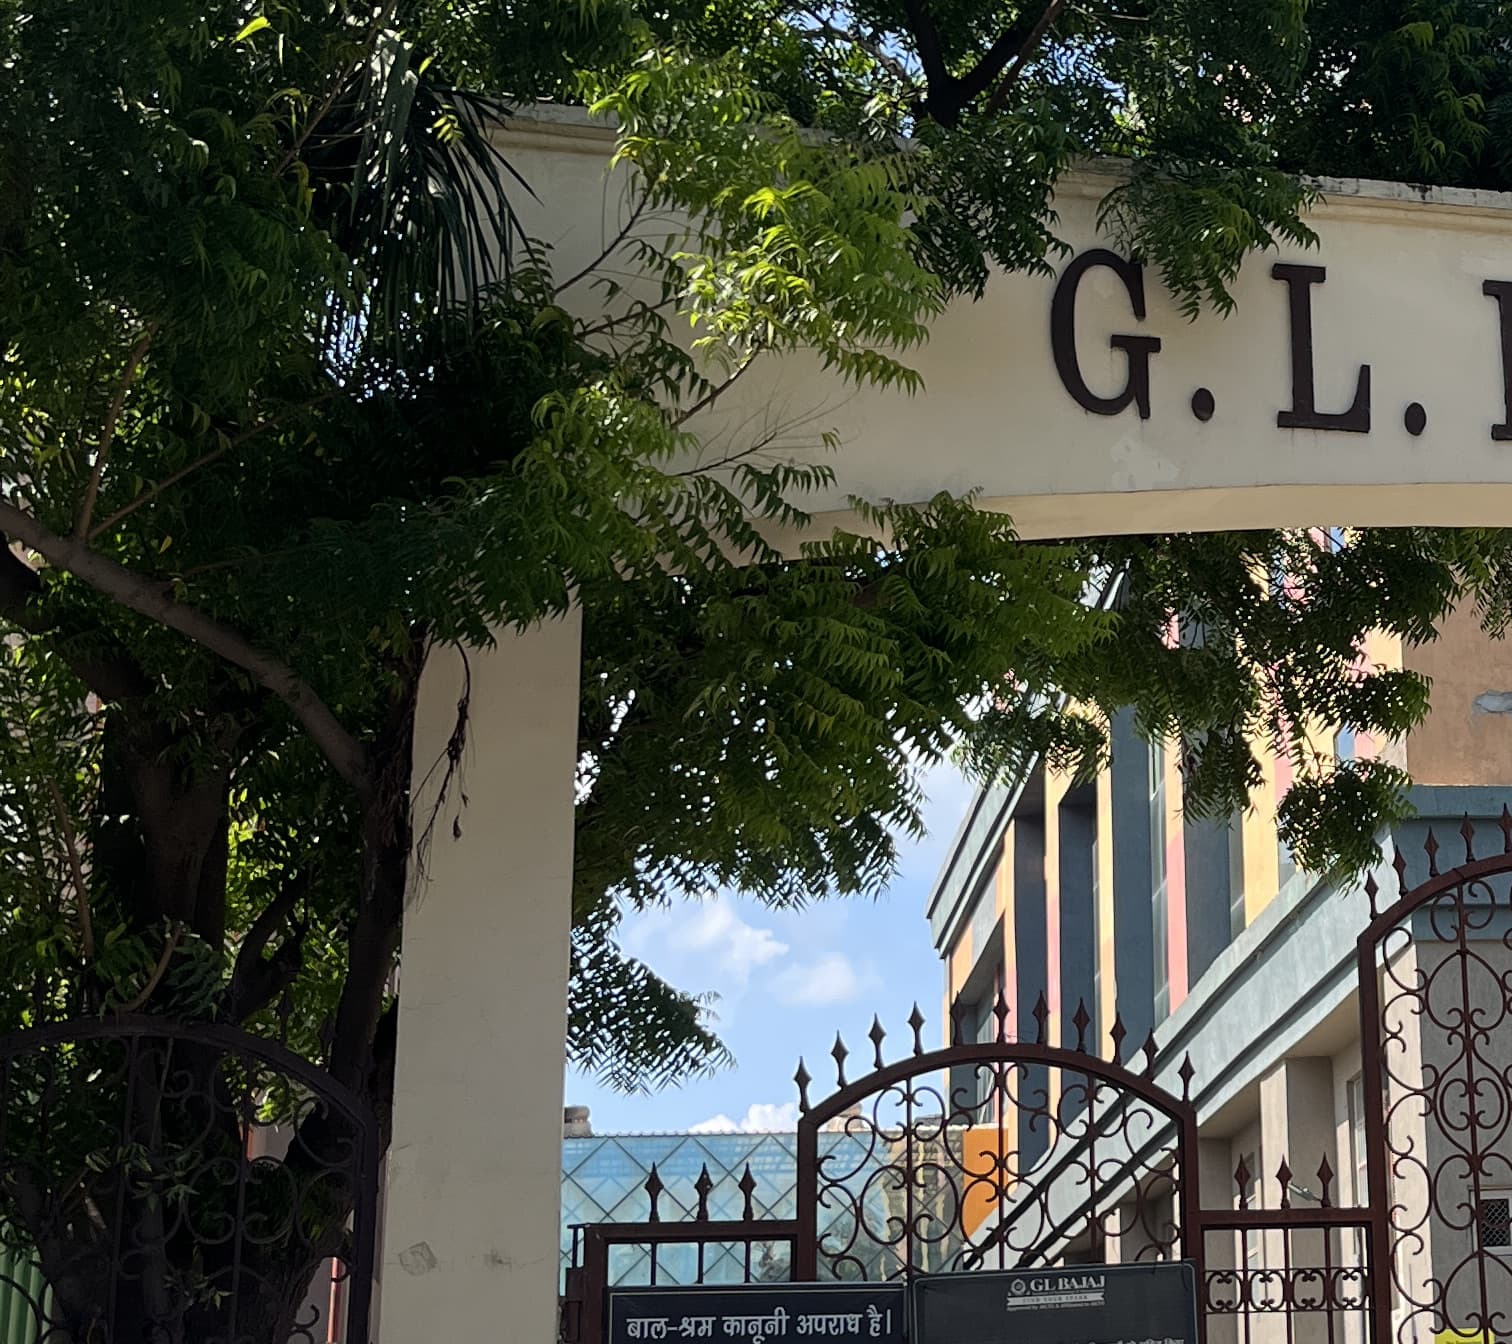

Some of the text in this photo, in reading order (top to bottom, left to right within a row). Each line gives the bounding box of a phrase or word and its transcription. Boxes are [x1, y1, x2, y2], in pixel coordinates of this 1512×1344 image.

[1030, 1275, 1105, 1291] GL BAJAJ
[626, 1316, 716, 1339] बाल-श्रम
[796, 1313, 863, 1336] अपराध
